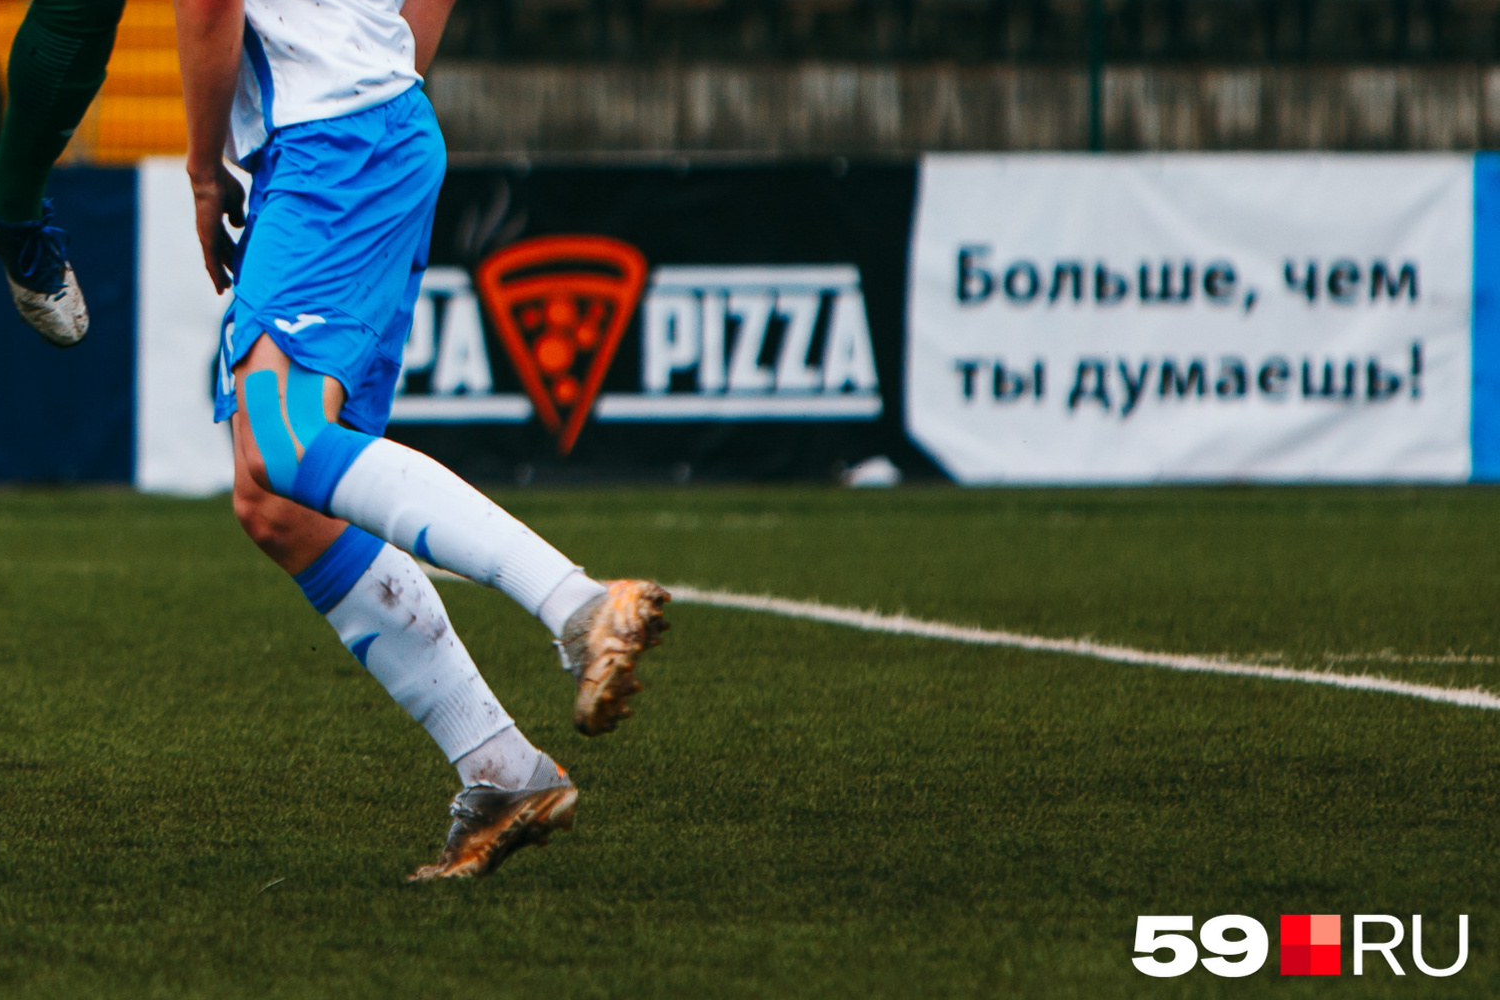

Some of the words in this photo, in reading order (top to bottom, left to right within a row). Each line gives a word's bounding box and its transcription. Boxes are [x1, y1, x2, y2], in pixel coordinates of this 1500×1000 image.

[955, 244, 1259, 316] Больше,
[1282, 257, 1421, 303] чем
[644, 288, 880, 396] PIZZA
[954, 357, 1046, 400] ты
[1067, 338, 1424, 418] думаешь!
